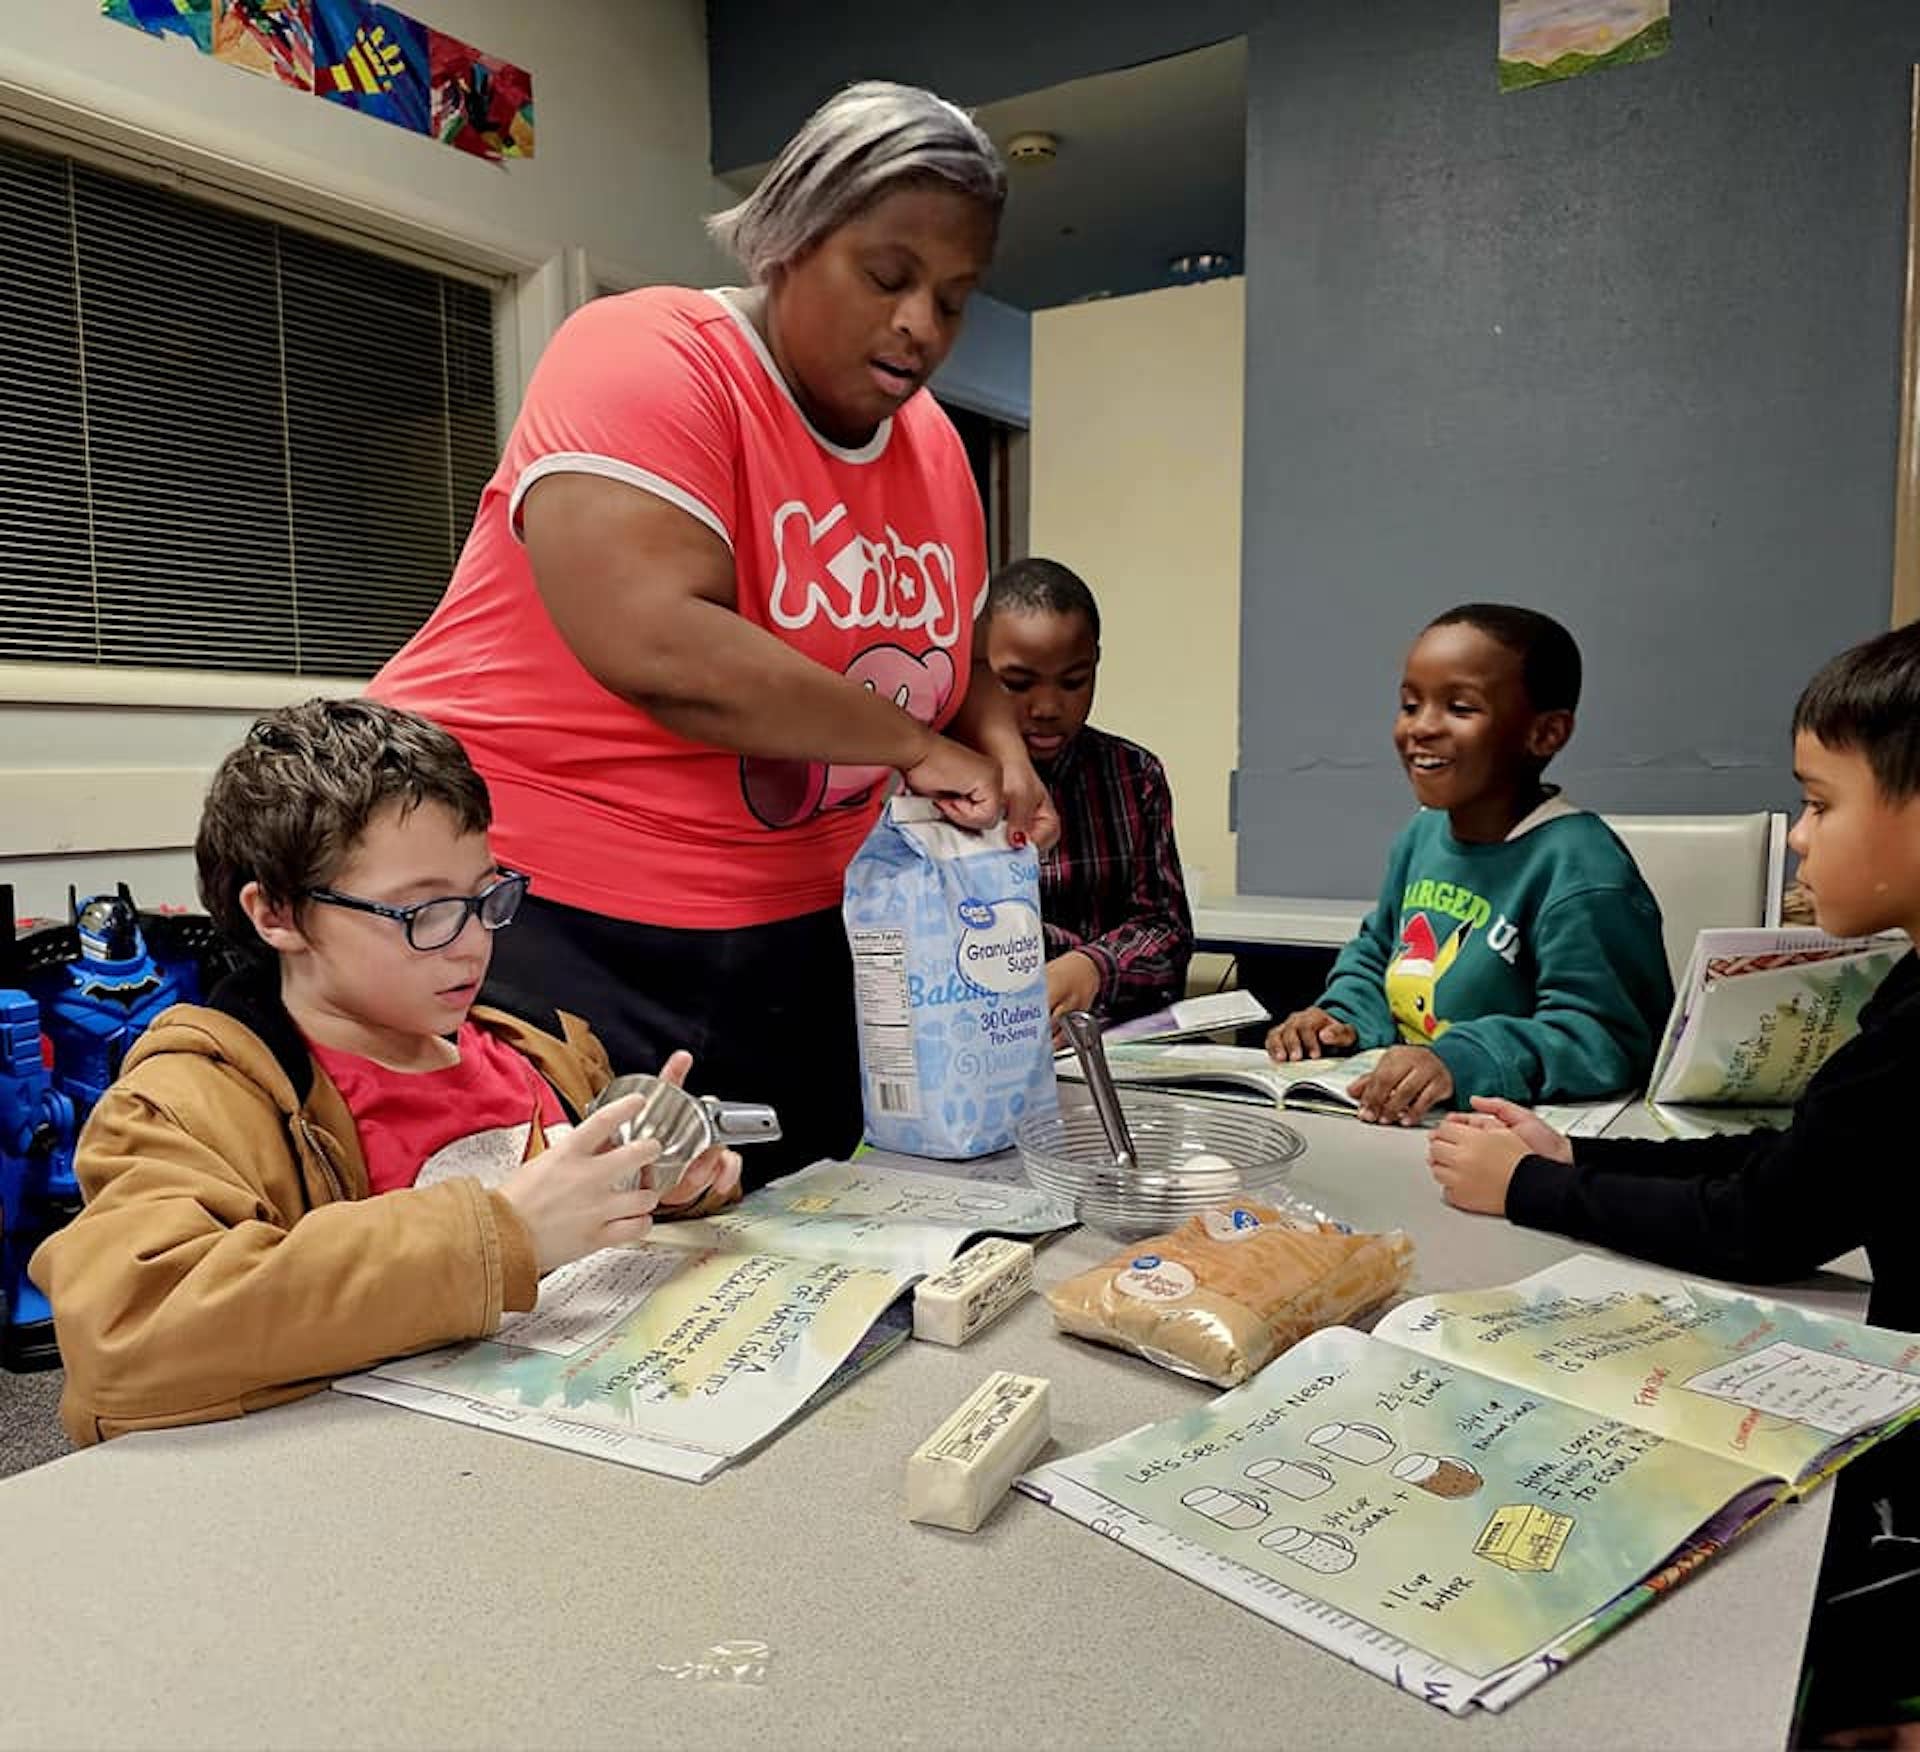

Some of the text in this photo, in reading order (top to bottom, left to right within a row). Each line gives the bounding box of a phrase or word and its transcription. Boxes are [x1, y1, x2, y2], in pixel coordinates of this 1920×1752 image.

[769, 500, 960, 647] Kirby
[793, 1310, 816, 1327] IS
[769, 1329, 799, 1363] JUST
[1125, 1456, 1180, 1484] Let's
